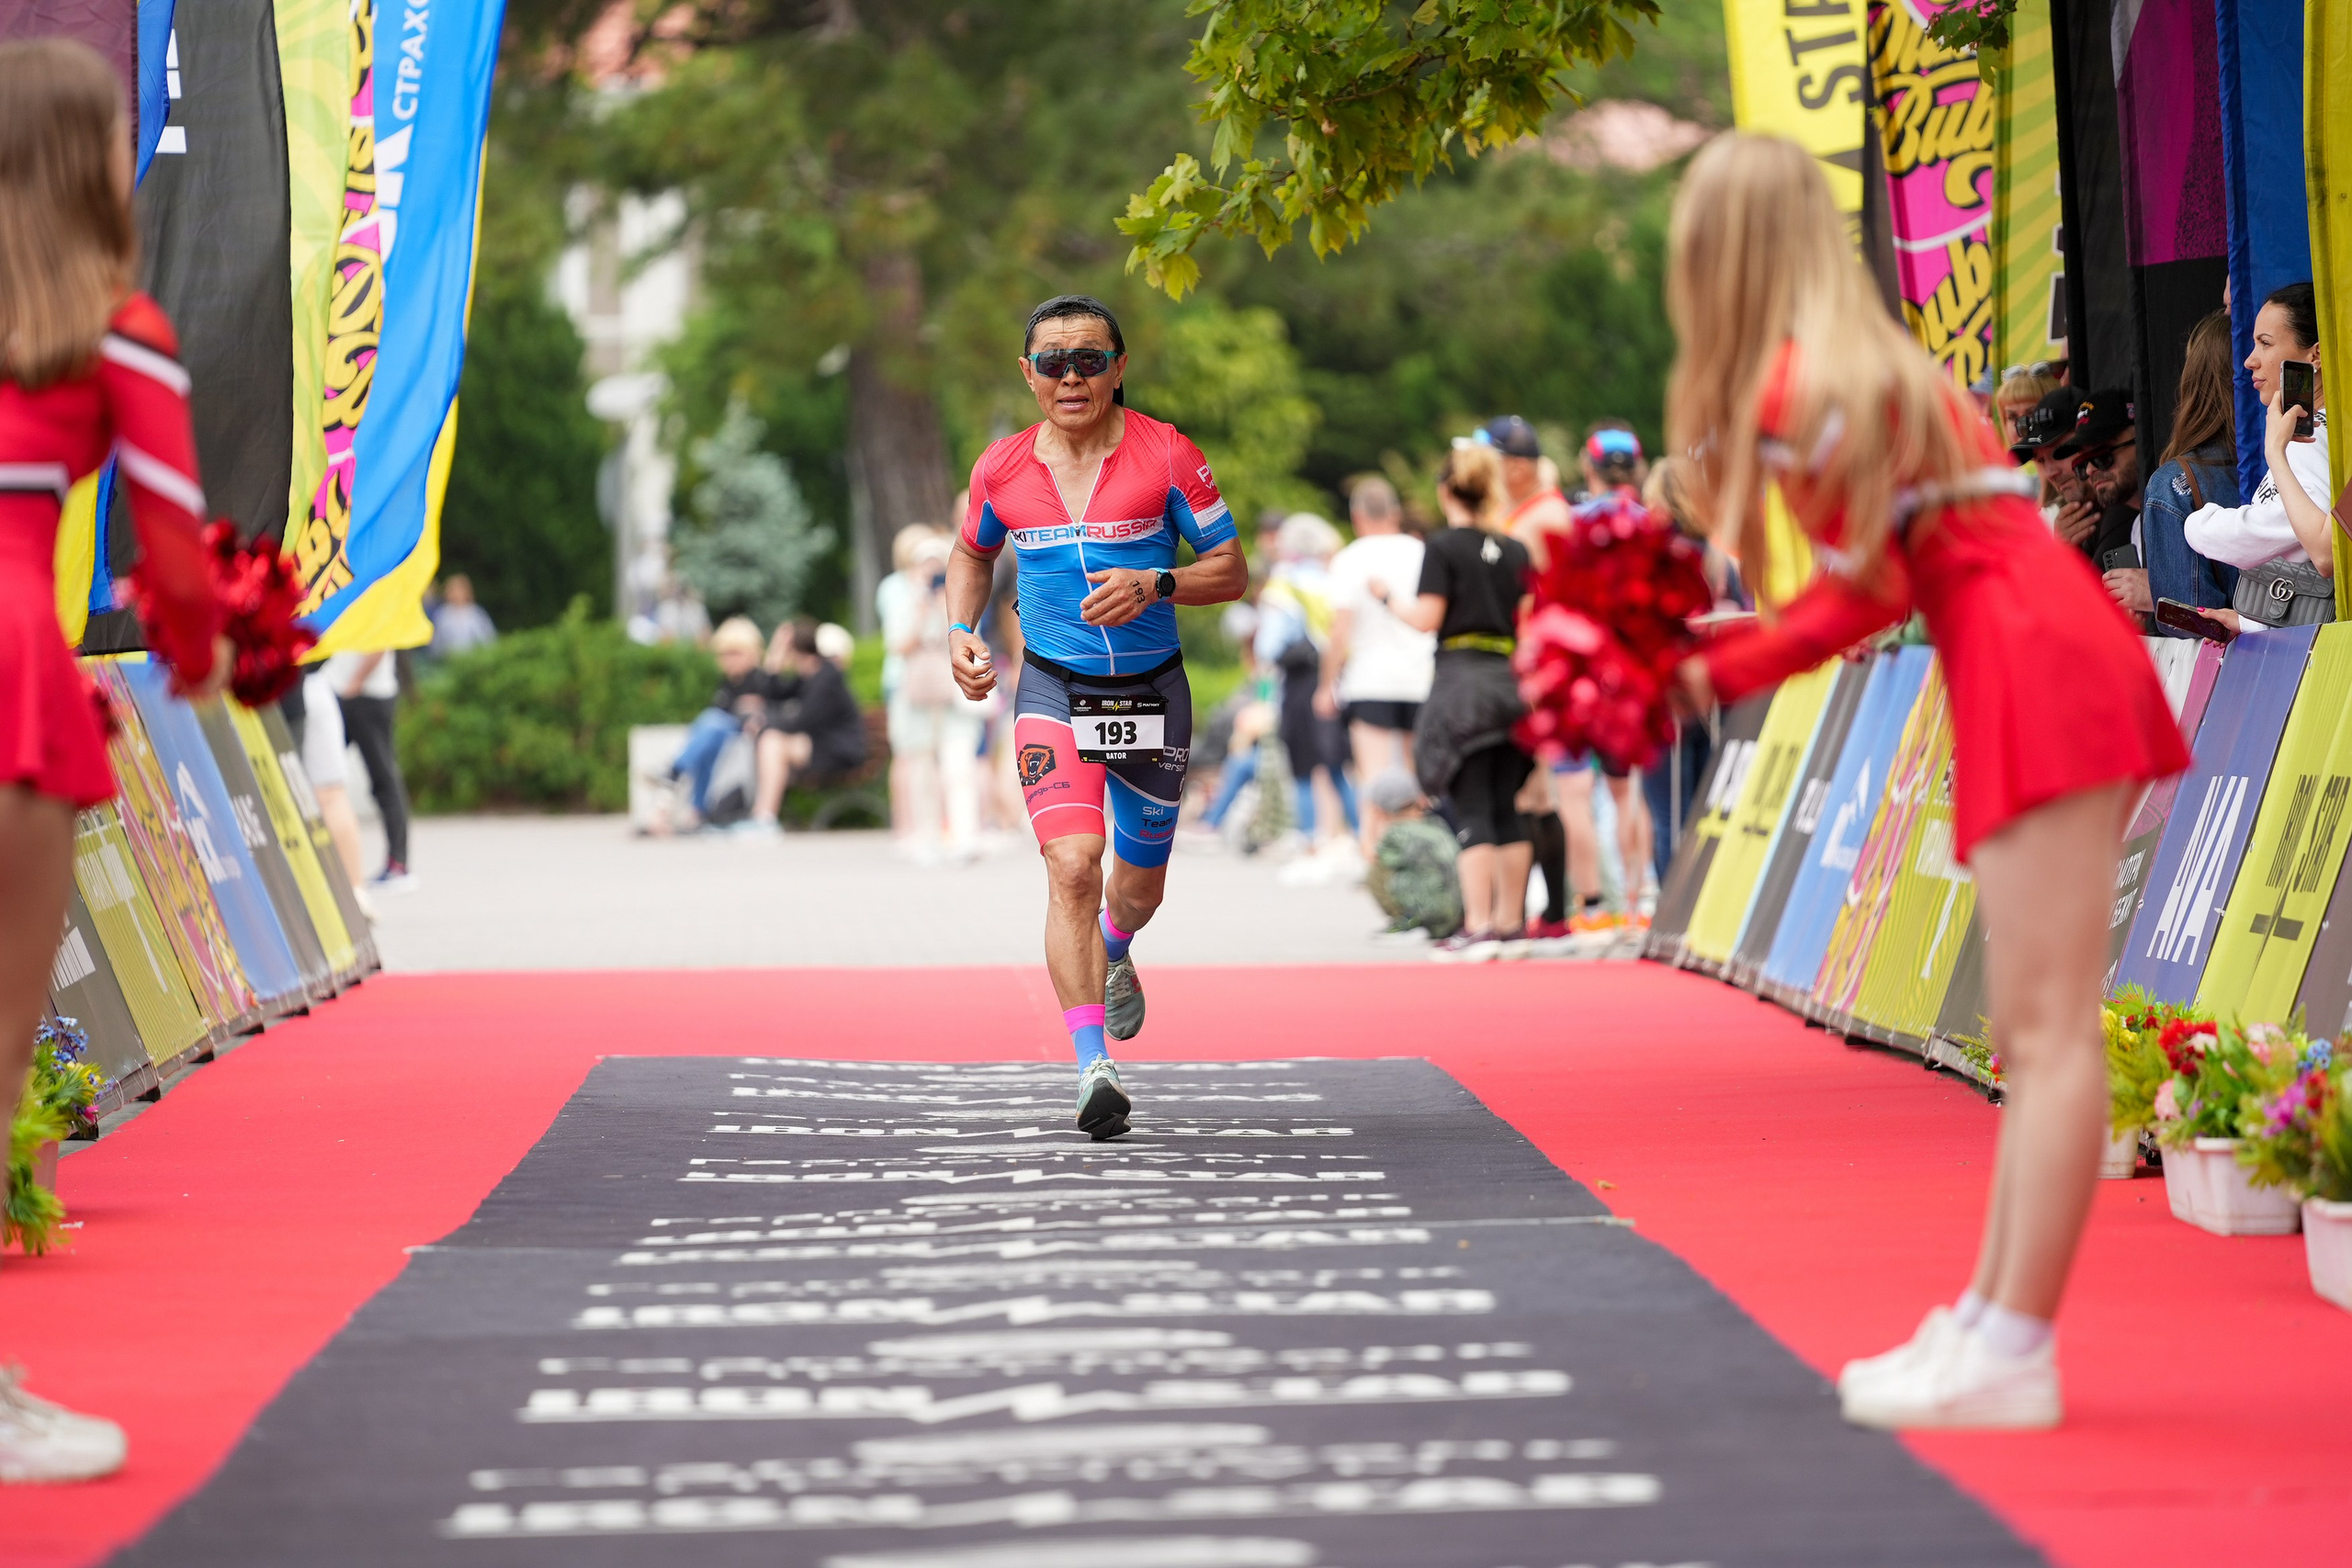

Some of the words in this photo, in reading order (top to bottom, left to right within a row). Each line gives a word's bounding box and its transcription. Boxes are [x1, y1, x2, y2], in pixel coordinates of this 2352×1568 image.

[1132, 580, 1146, 604] 193
[1094, 721, 1137, 745] 193
[1141, 817, 1173, 828] Team
[1142, 807, 1164, 816] Ski
[2292, 774, 2352, 893] STAR
